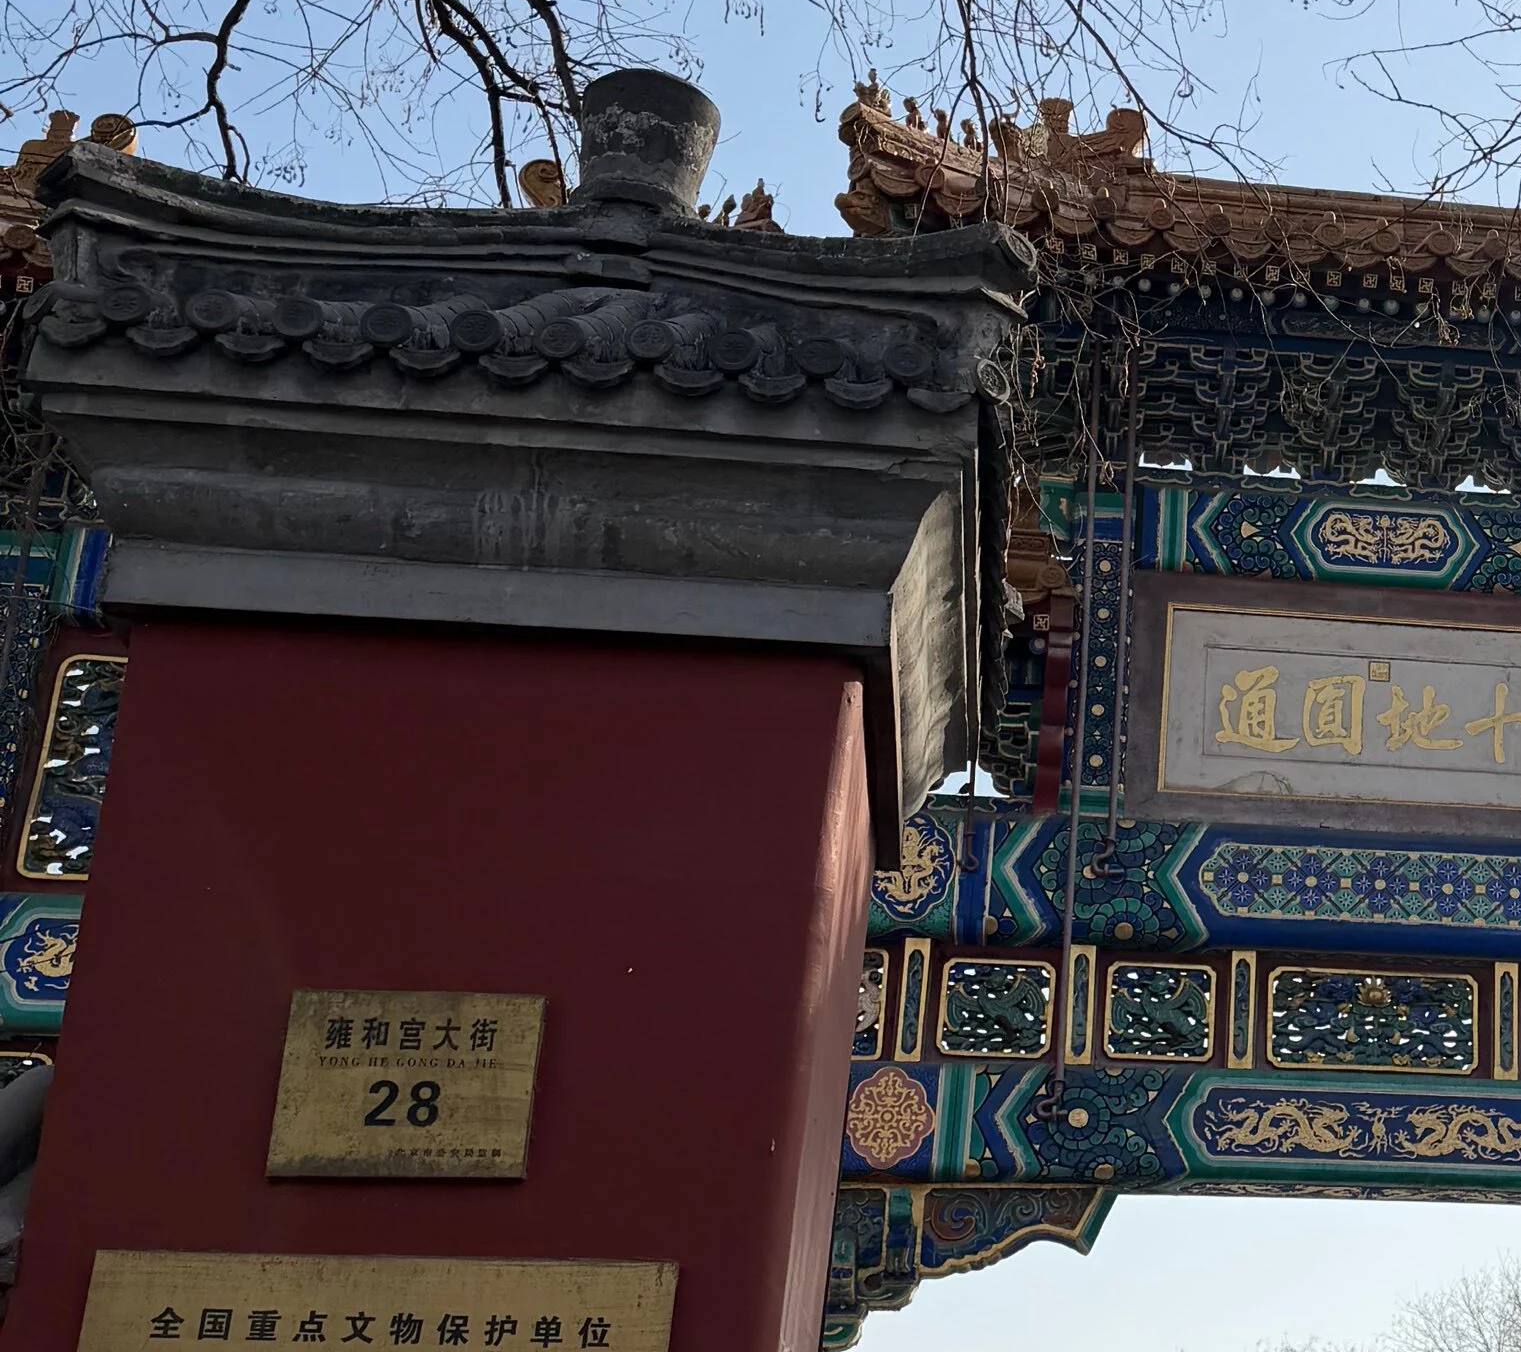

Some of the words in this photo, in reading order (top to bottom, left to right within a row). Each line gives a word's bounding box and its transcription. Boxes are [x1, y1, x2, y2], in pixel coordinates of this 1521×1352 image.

[325, 1016, 499, 1052] 雍和宫大街
[319, 1056, 360, 1067] YONG
[368, 1057, 389, 1067] HE
[396, 1058, 439, 1068] GONG
[446, 1058, 466, 1068] DA
[364, 1080, 441, 1128] 28
[149, 1307, 611, 1349] 全国重点文物保护单位
